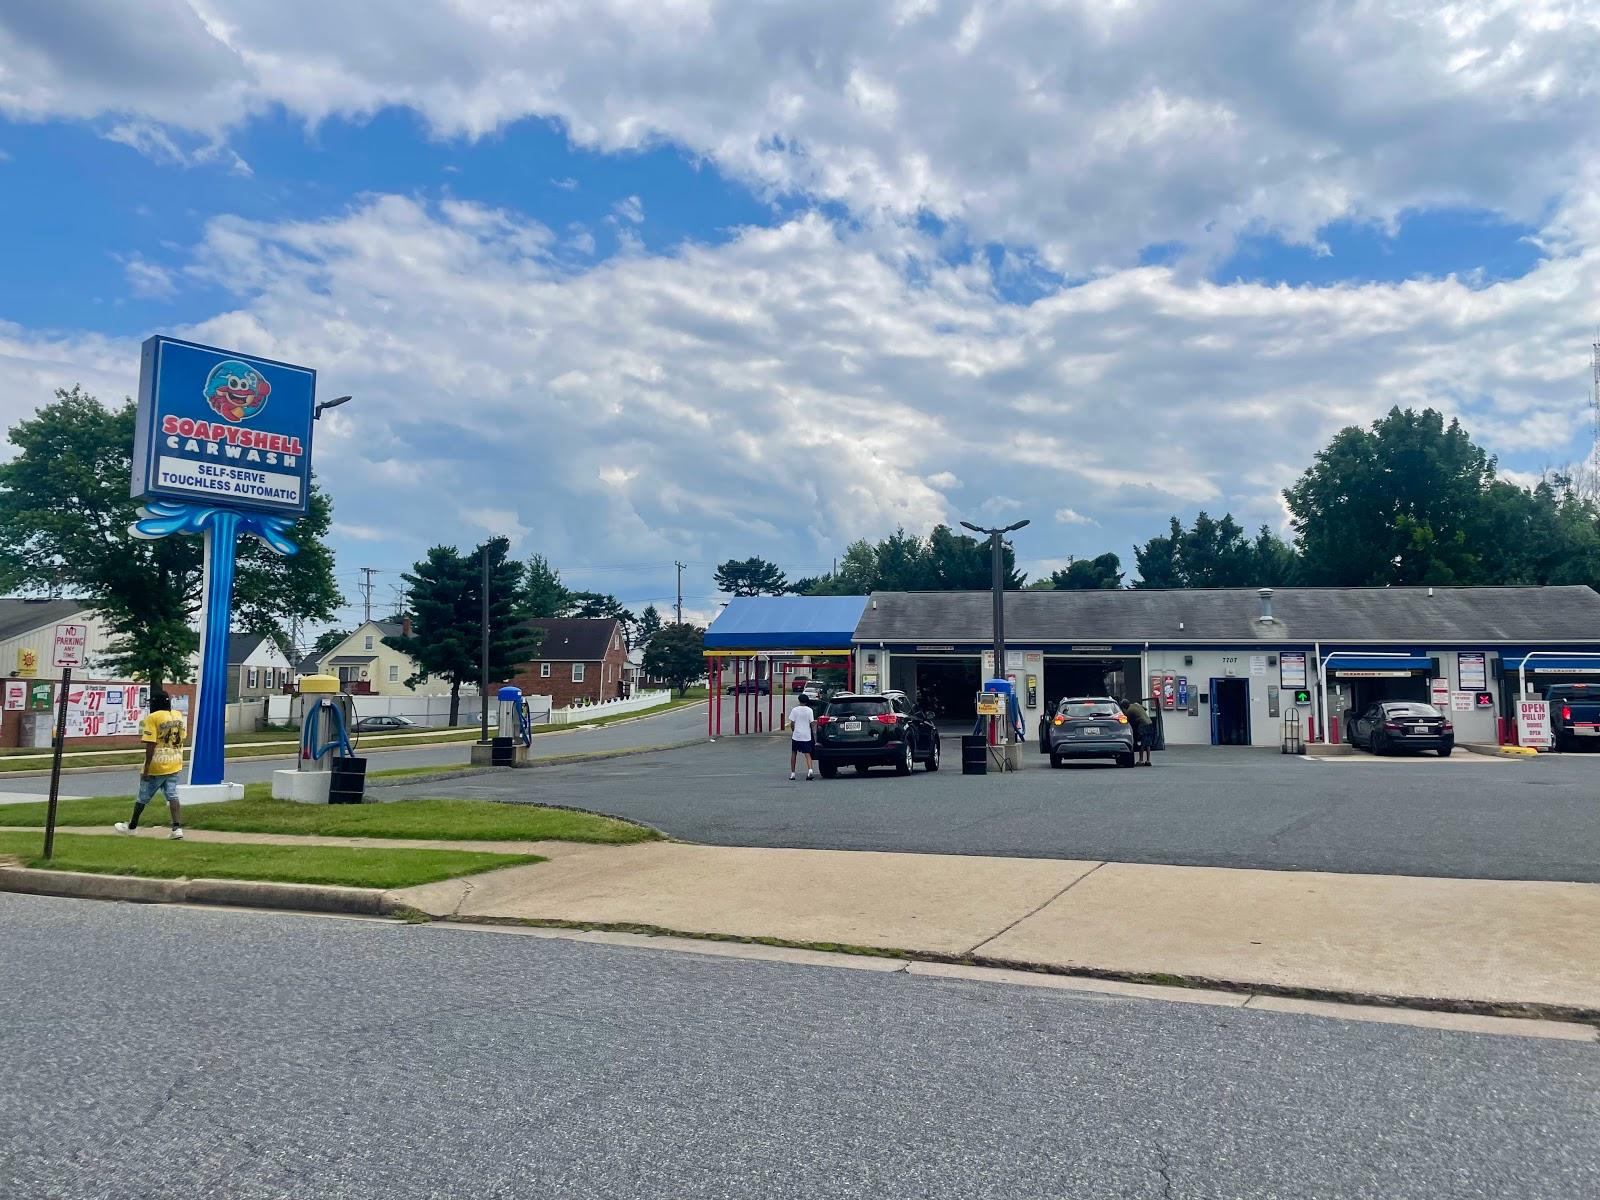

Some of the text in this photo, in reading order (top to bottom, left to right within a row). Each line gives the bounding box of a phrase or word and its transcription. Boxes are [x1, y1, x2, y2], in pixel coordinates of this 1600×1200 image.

[162, 414, 302, 456] SOAPYSHELL
[198, 464, 266, 483] SELF-SERVE
[162, 472, 297, 500] TOUCHLESS AUTOMATIC
[65, 627, 77, 636] NO
[56, 637, 83, 646] PARKING
[1521, 703, 1545, 713] OPEN
[1522, 713, 1537, 721] PULL
